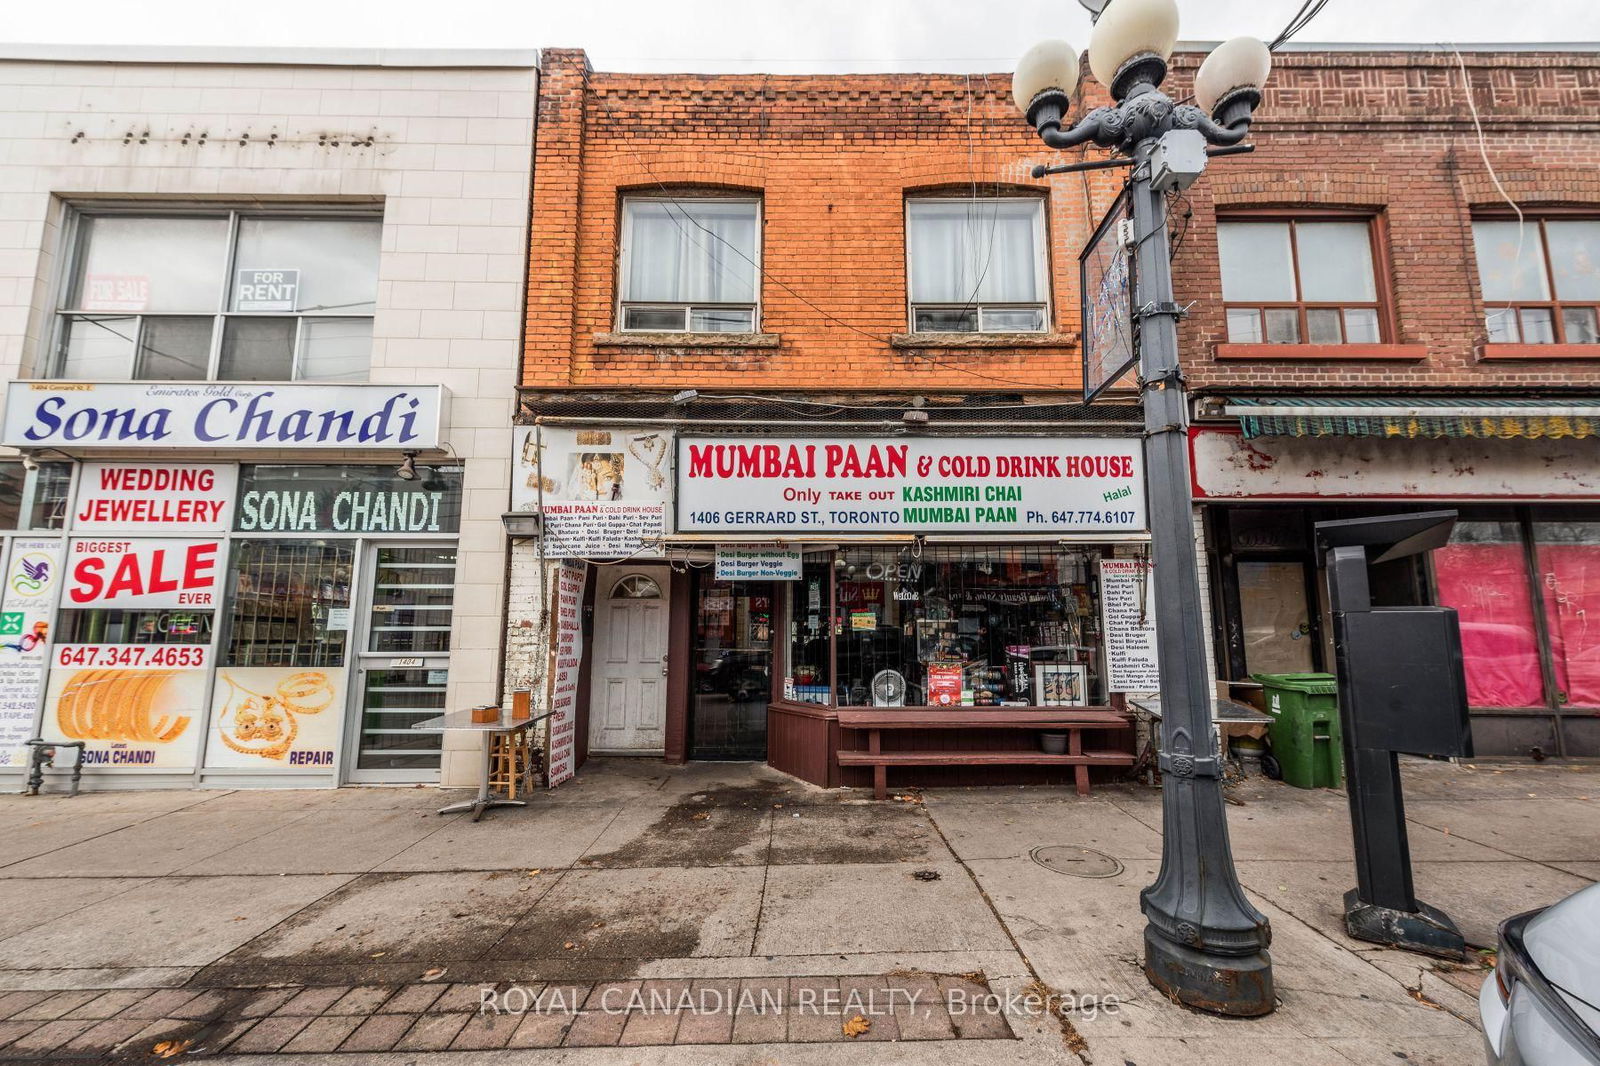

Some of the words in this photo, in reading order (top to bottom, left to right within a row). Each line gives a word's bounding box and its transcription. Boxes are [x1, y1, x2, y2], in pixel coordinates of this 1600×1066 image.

[254, 272, 284, 283] FOR
[92, 281, 114, 298] FOR
[118, 281, 147, 298] SALE
[239, 284, 295, 300] RENT
[146, 386, 200, 397] Emirates
[203, 385, 233, 397] Gold
[24, 397, 172, 441] Sona
[194, 391, 420, 443] Chandi
[689, 444, 816, 478] MUMBAI
[824, 444, 909, 478] PAAN
[917, 456, 933, 477] &
[938, 456, 991, 478] COLD
[996, 456, 1061, 478] DRINK
[1066, 456, 1134, 478] HOUSE
[101, 469, 215, 492] WEDDING
[783, 487, 821, 505] Only
[829, 491, 862, 500] TAKE
[869, 491, 895, 500] OUT
[902, 486, 980, 502] KASHMIRI
[985, 486, 1022, 502] CHAI
[1103, 486, 1132, 502] Halal
[79, 500, 225, 522] JEWELLERY
[240, 490, 317, 531] SONA
[332, 491, 443, 532] CHANDI
[575, 505, 598, 514] PAAN
[903, 507, 970, 523] MUMBAI
[974, 507, 1017, 523] PAAN
[1027, 511, 1048, 524] Ph.
[1052, 511, 1135, 524] 647.774.6107
[690, 511, 720, 524] 1406
[724, 511, 796, 524] GERRARD
[801, 511, 825, 526] ST.,
[829, 511, 900, 524] TORONTO
[76, 543, 131, 553] BIGGEST
[70, 543, 218, 603] SALE
[866, 562, 922, 580] OPEN
[178, 593, 212, 604] EVER
[60, 646, 204, 666] 647.347.4653
[112, 750, 155, 764] CHANDI
[290, 751, 334, 765] REPAIR
